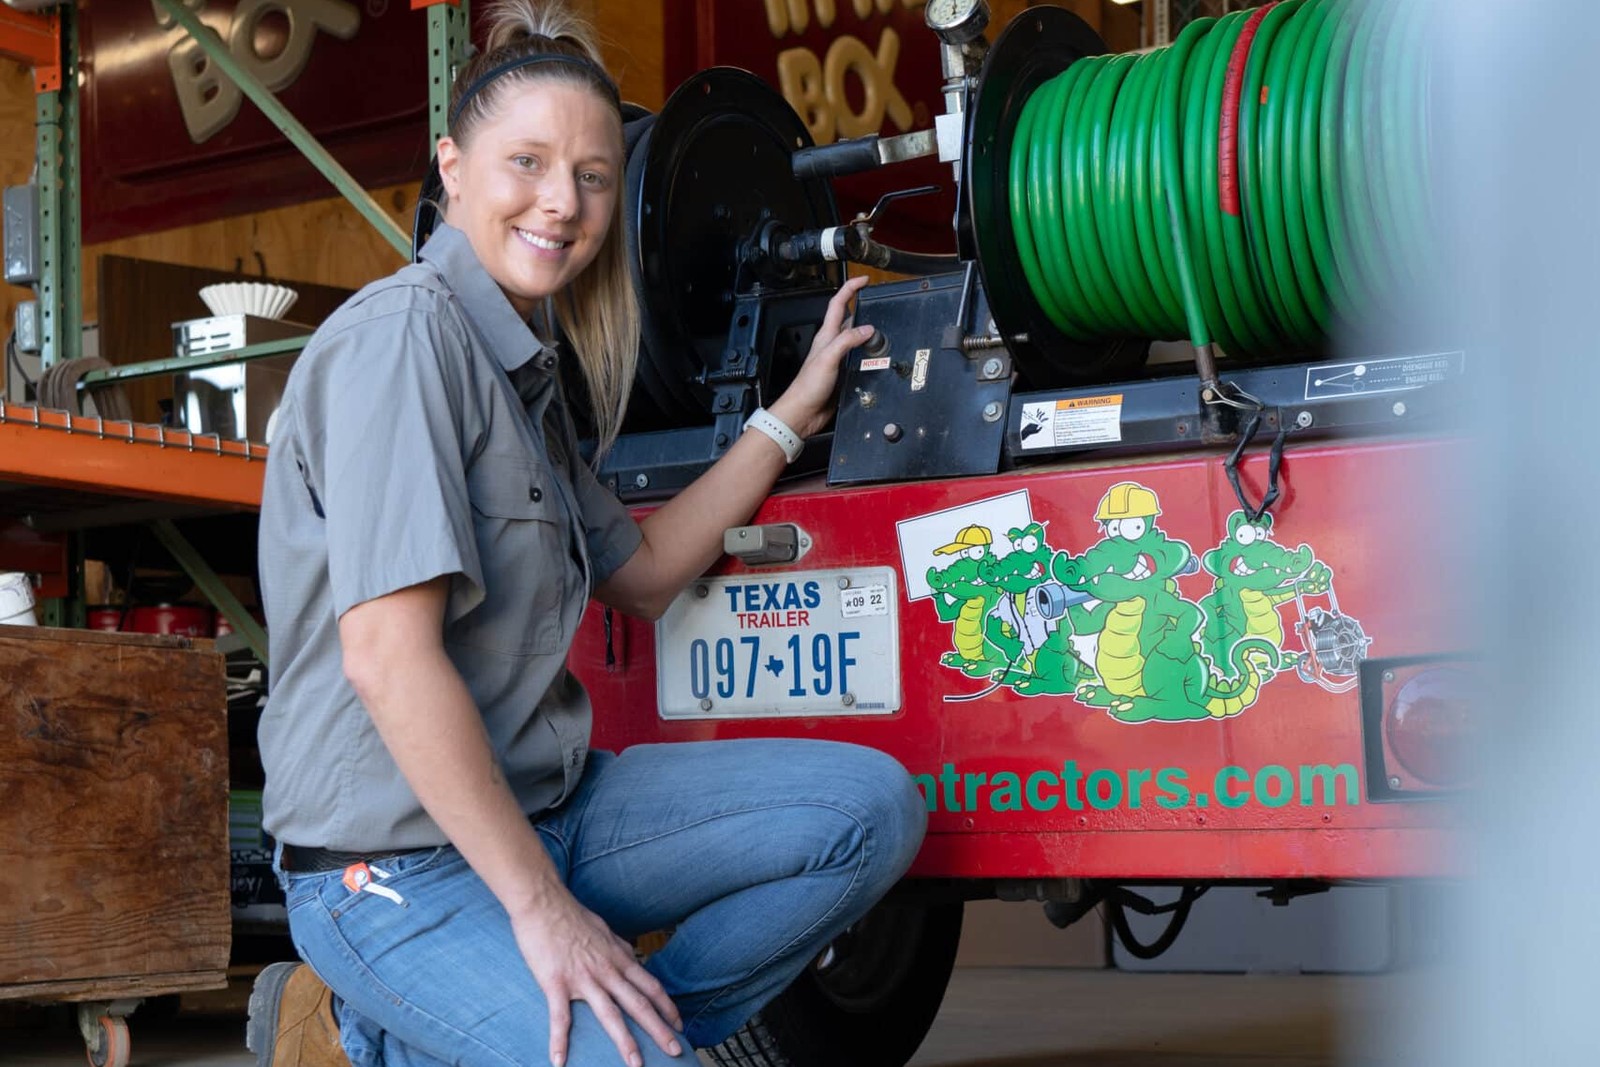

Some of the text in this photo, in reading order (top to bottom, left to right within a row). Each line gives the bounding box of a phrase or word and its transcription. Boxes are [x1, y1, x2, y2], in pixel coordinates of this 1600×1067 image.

[777, 27, 914, 145] BOX
[1077, 397, 1112, 406] WARNING
[725, 581, 821, 613] TEXAS
[853, 594, 882, 607] 09 22
[736, 610, 810, 629] TRAILER
[690, 631, 860, 699] 097 19F
[910, 760, 1360, 813] ntractors.com
